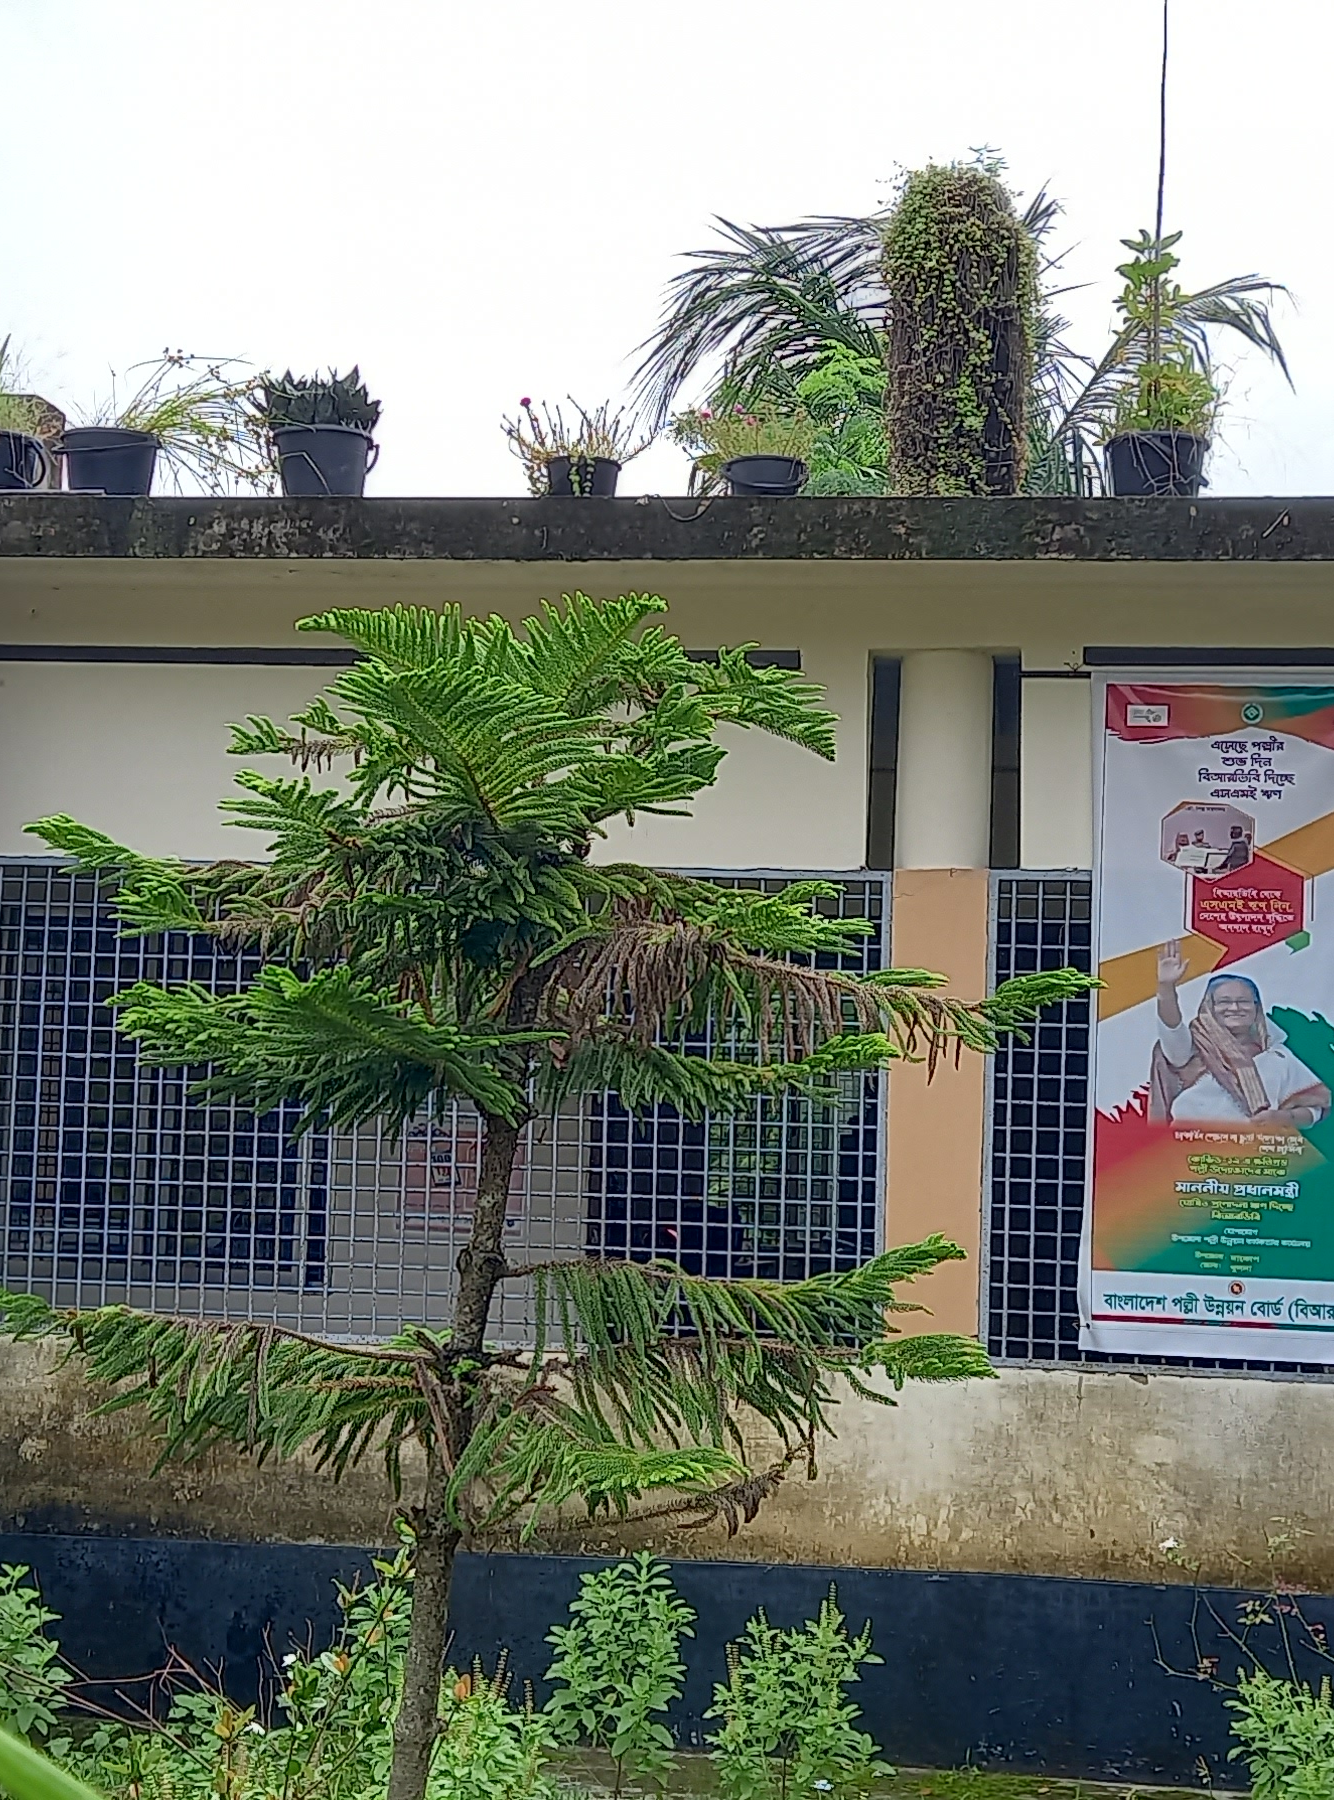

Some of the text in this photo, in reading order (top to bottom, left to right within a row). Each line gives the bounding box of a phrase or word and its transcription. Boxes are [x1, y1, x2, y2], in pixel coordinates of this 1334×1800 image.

[1211, 740, 1248, 753] এসেছে
[1221, 752, 1273, 768] শুভ দিন
[1198, 768, 1296, 787] বিআরডিবি দিচ্ছে
[1210, 785, 1257, 800] এসএমই
[1175, 1178, 1299, 1199] মাননীয় প্রধানমন্ত্রী
[1103, 1293, 1167, 1312] বাংলাদেশ
[1171, 1292, 1200, 1314] পল্লী
[1203, 1293, 1246, 1318] উন্নয়ন
[1251, 1296, 1284, 1318] বোর্ড
